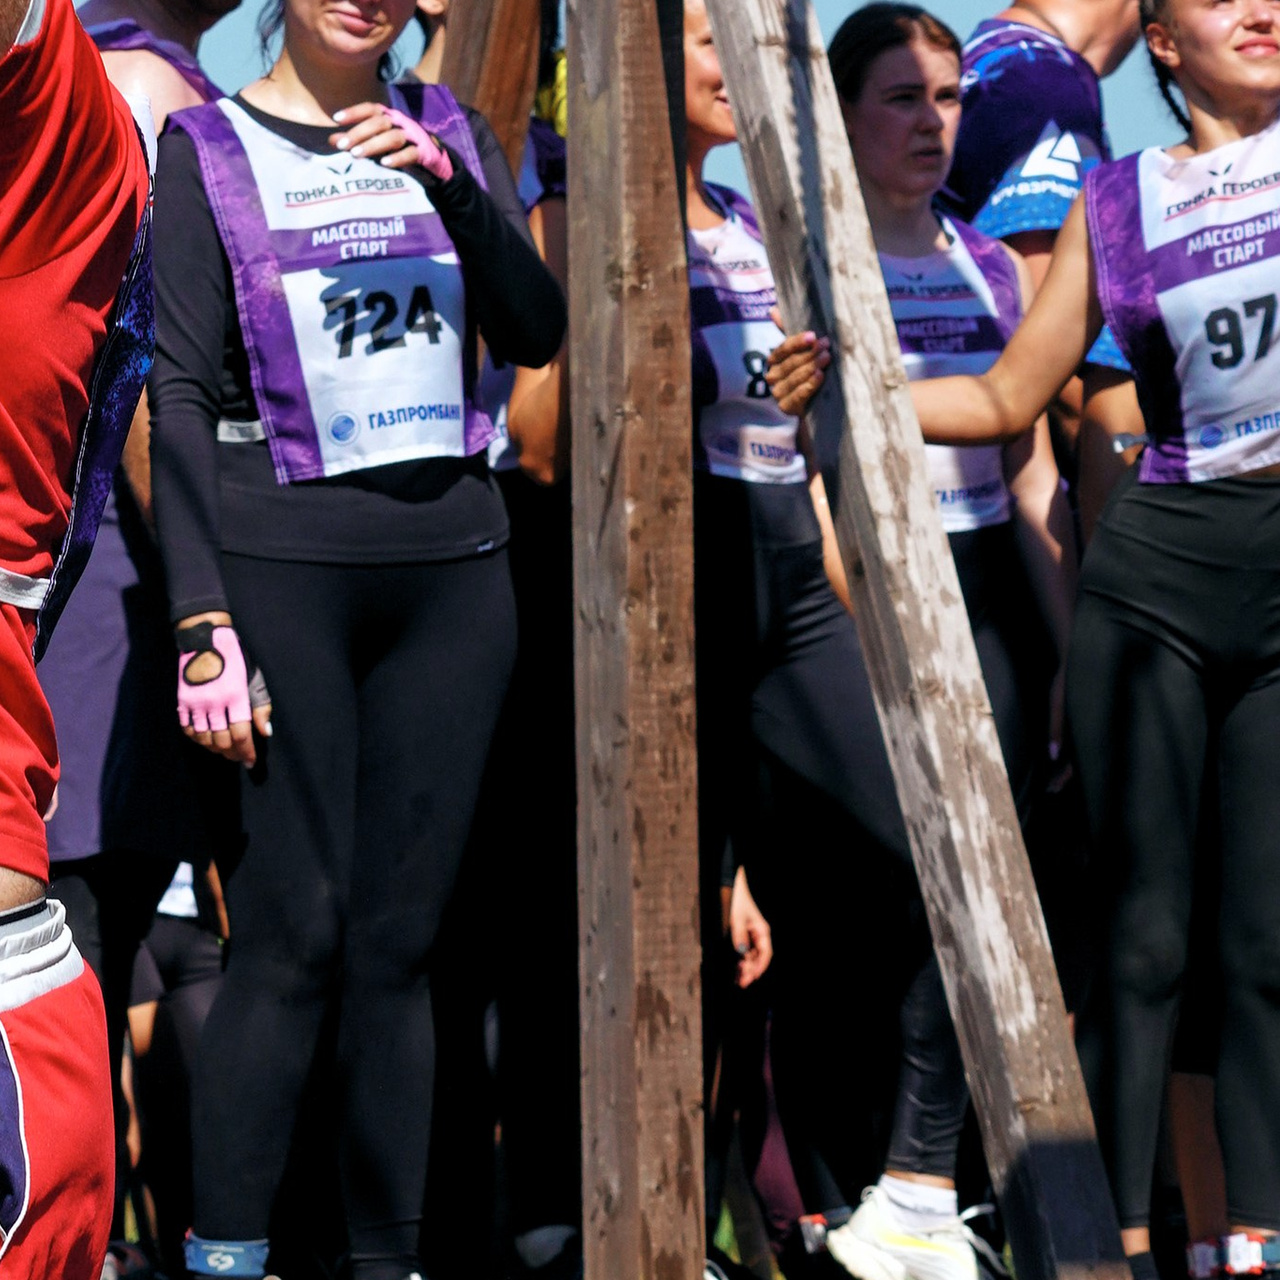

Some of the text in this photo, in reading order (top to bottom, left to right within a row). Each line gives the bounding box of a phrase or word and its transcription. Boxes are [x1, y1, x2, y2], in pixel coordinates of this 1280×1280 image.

[285, 177, 405, 204] ГОНКА ГЕРОЕВ
[1166, 187, 1217, 216] ГОНКА
[312, 216, 406, 247] МАССОВЫЙ
[340, 240, 389, 260] СТАРТ
[1213, 237, 1266, 269] СТАРТ
[324, 285, 443, 360] 724
[1204, 293, 1278, 371] 97
[742, 350, 772, 399] 8
